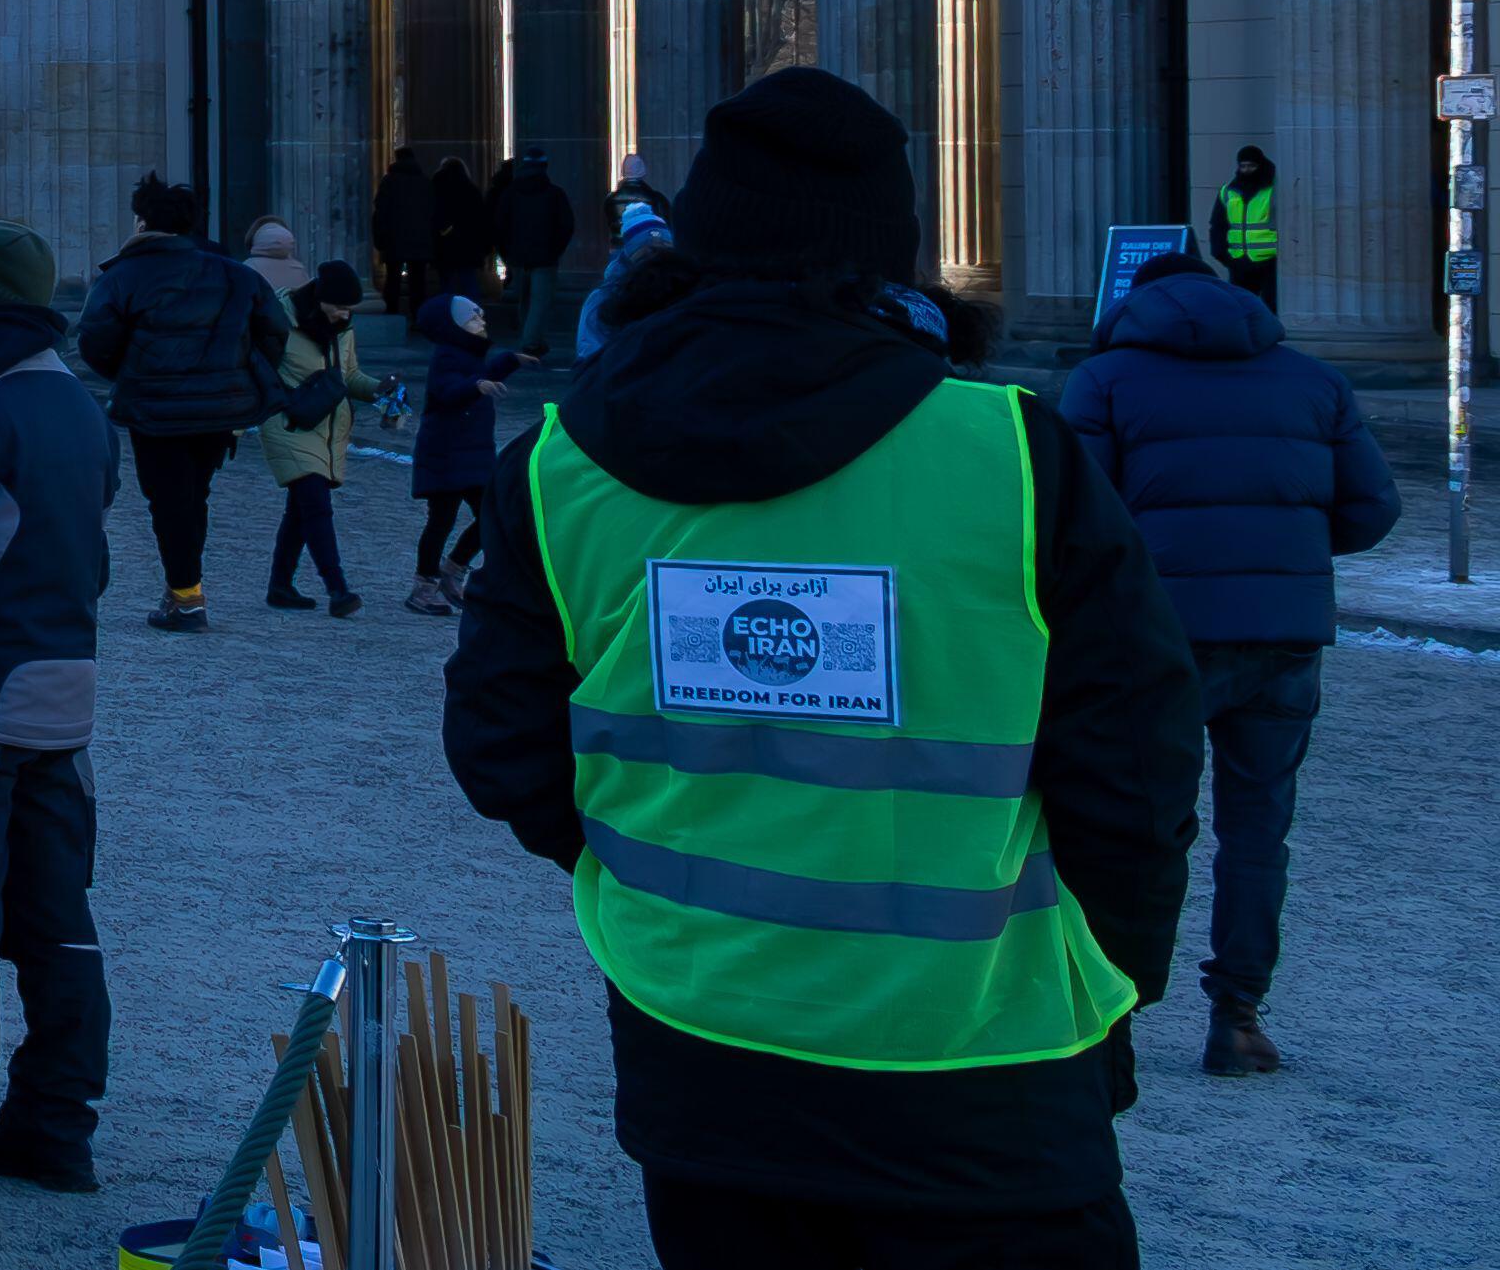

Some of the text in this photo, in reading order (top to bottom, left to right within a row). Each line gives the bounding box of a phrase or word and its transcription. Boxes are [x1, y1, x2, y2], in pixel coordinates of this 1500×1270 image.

[704, 575, 829, 598] آزادی برای ایران
[733, 616, 812, 638] ECHO
[748, 637, 816, 658] IRAN
[669, 684, 882, 710] FREEDOM FOR IRAN
